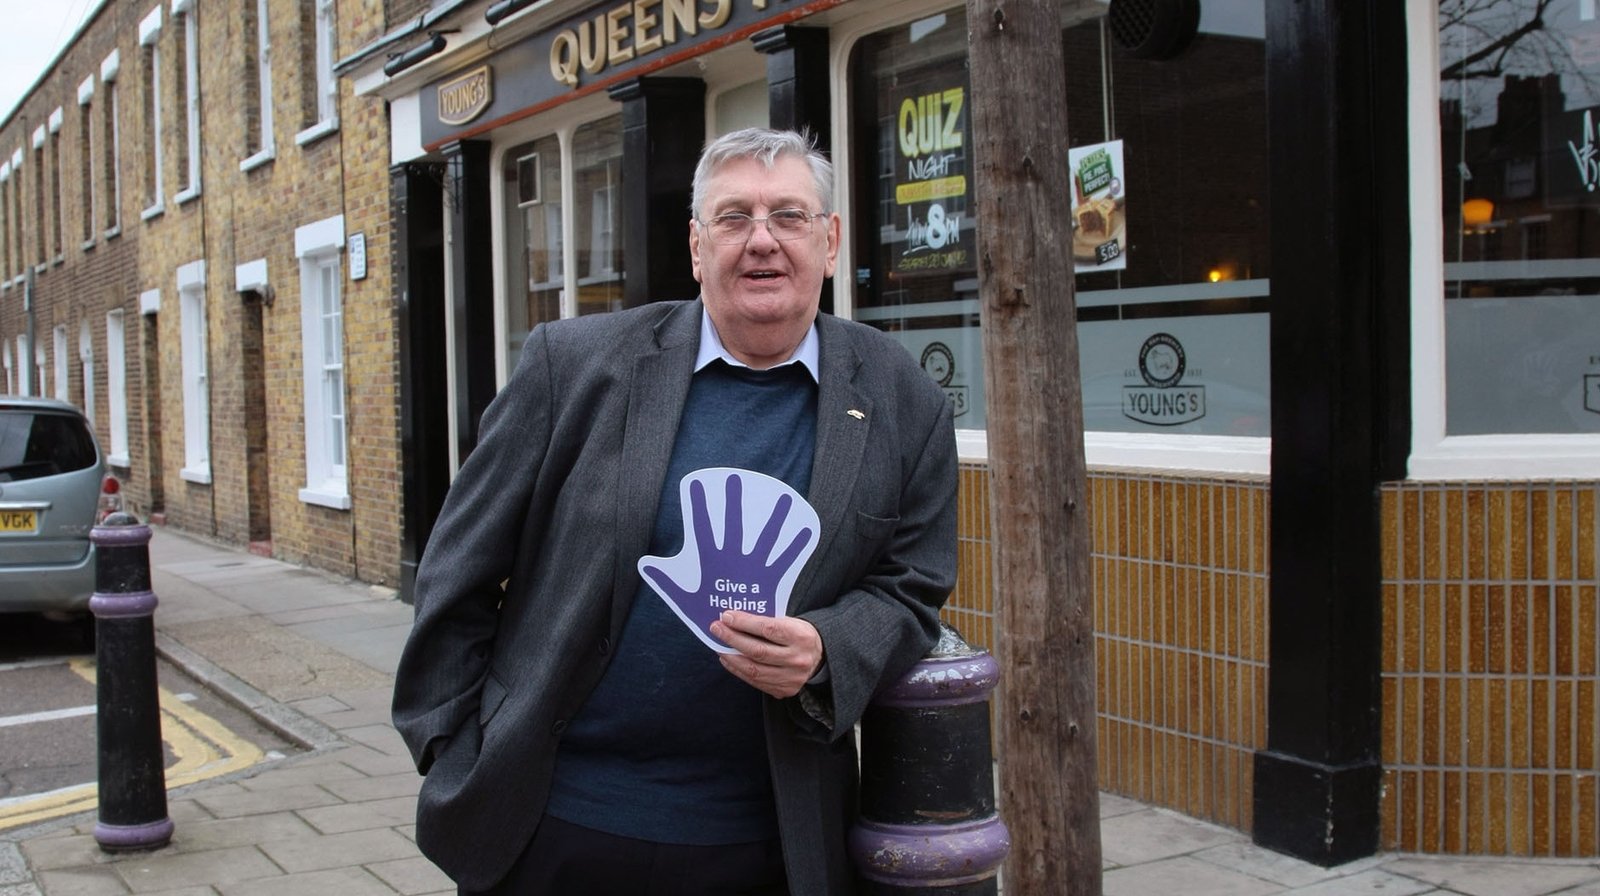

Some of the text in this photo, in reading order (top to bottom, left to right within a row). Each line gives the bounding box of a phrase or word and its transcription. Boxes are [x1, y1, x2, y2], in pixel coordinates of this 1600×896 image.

[442, 77, 484, 114] YOUNG'S
[898, 87, 964, 158] QUIZ
[908, 153, 957, 181] NIGHT
[1128, 391, 1198, 416] YOUNG'S
[1, 513, 32, 528] VGK
[715, 579, 760, 593] Give a
[710, 595, 767, 613] Helping
